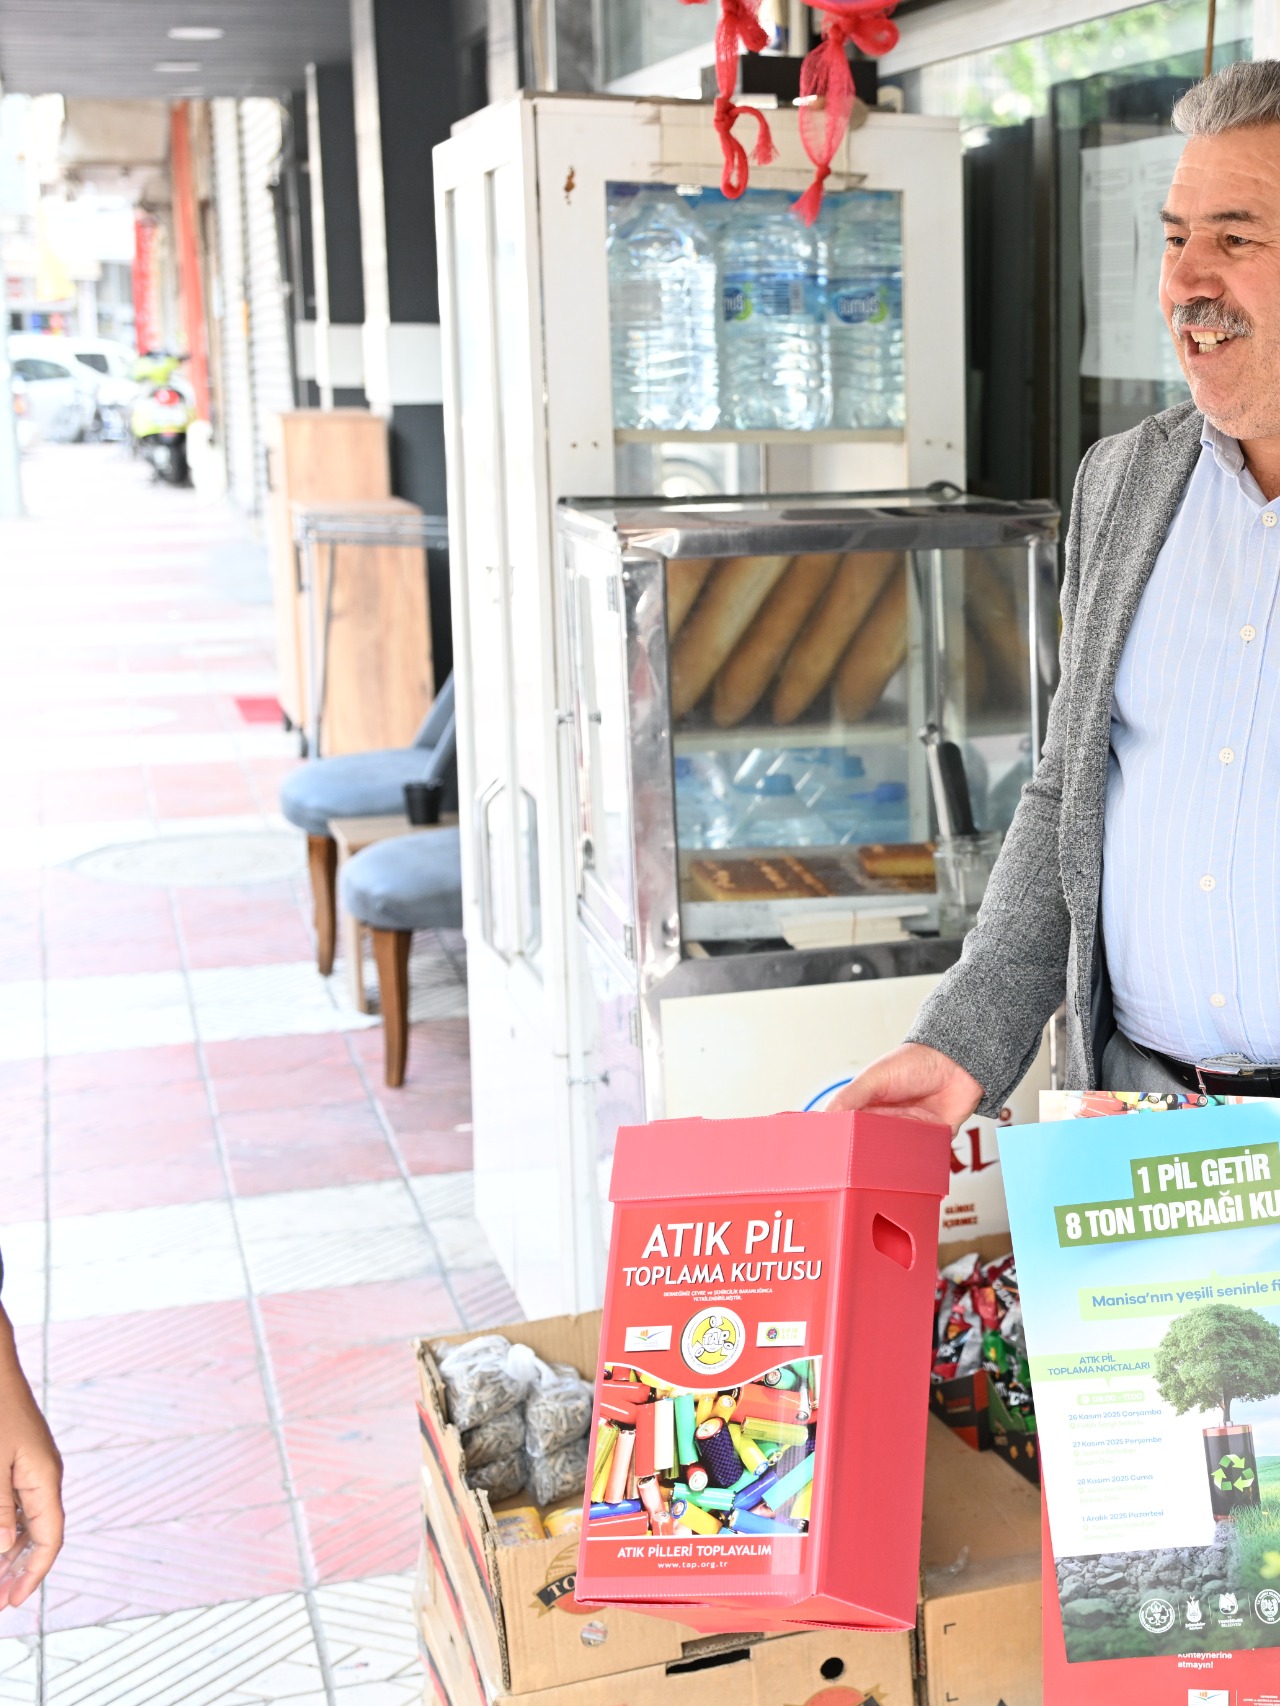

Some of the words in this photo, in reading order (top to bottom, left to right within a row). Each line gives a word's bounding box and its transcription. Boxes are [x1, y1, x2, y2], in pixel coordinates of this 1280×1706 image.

[1137, 1166, 1151, 1194] 1
[1157, 1156, 1197, 1192] PİL
[1201, 1149, 1272, 1188] GETİR
[1065, 1212, 1083, 1240] 8
[1085, 1206, 1136, 1238] TON
[1138, 1189, 1245, 1233] TOPRAĞI
[641, 1221, 732, 1259] ATIK
[745, 1210, 806, 1254] PİL
[622, 1263, 725, 1287] TOPLAMA
[731, 1260, 823, 1282] KUTUSU
[1176, 1285, 1214, 1306] yeşili
[1216, 1281, 1269, 1298] seninle
[703, 1329, 730, 1346] TAP
[1079, 1355, 1099, 1365] ATIK
[1101, 1352, 1116, 1363] PİL
[1048, 1363, 1094, 1376] TOPLAMA
[1096, 1361, 1150, 1373] NOKTALARI
[1079, 1411, 1102, 1420] Kasım
[1103, 1410, 1121, 1418] 2025
[1122, 1408, 1162, 1419] Çarşamba
[1072, 1440, 1081, 1448] 27
[1081, 1439, 1105, 1447] Kasım
[1105, 1437, 1124, 1446] 2025
[1125, 1435, 1163, 1446] Perşembe
[1086, 1476, 1111, 1485] Kasım
[1111, 1475, 1130, 1483] 2025
[1130, 1474, 1154, 1482] Cuma
[1086, 1514, 1108, 1523] Aralık
[1109, 1512, 1128, 1520] 2025
[1129, 1509, 1164, 1518] Pazartesi
[617, 1546, 645, 1558] ATIK
[648, 1543, 693, 1558] PİLLERİ
[696, 1544, 772, 1556] TOPLAYALIM
[658, 1561, 728, 1569] www.tap.org.tr
[1178, 1660, 1214, 1671] atmayın!
